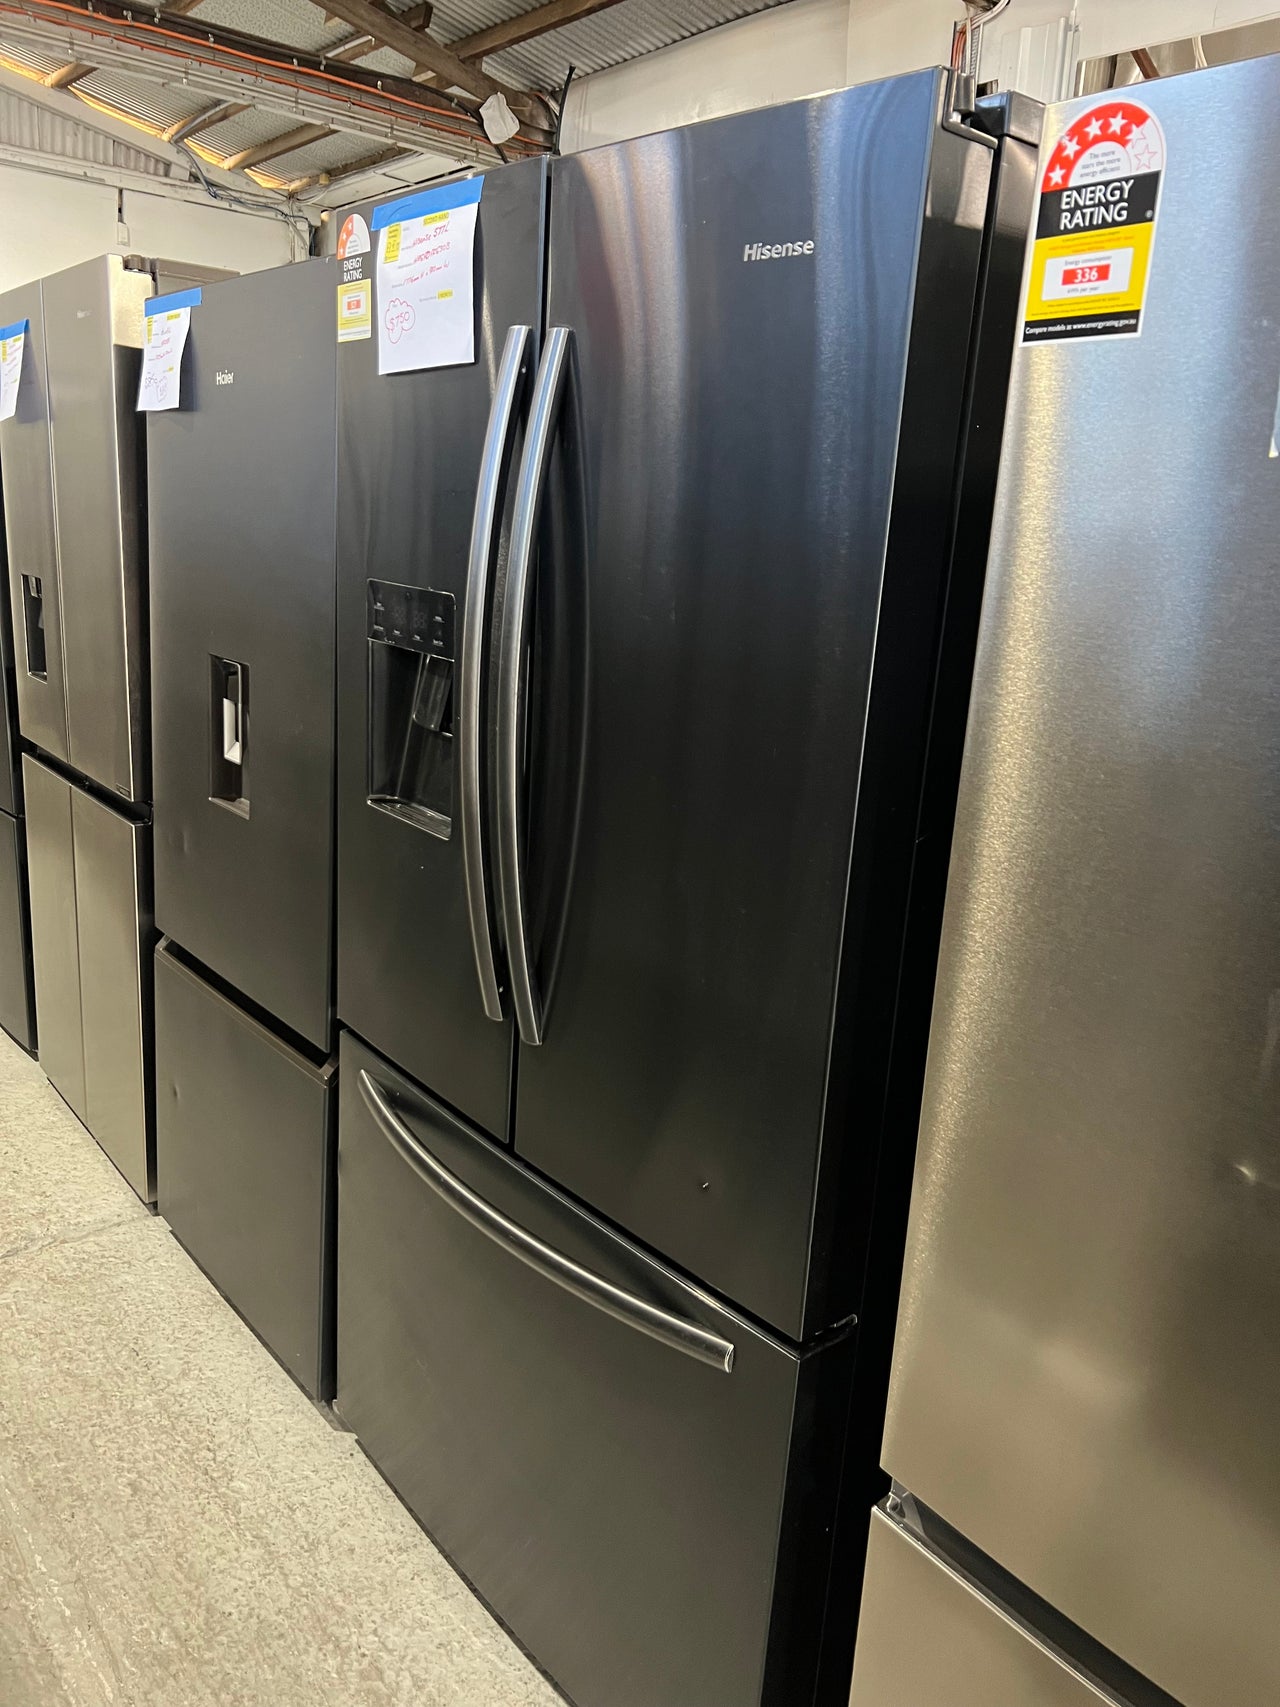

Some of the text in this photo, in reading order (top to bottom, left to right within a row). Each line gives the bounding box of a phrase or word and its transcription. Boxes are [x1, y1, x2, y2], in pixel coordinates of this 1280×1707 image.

[1061, 179, 1134, 210] ENERGY
[1060, 202, 1128, 230] RATING
[743, 240, 815, 262] Hisense
[343, 257, 363, 271] ENERGY
[343, 269, 363, 282] RATING
[1073, 267, 1098, 283] 336
[1025, 327, 1047, 335] Compare
[1048, 324, 1066, 332] models
[216, 369, 234, 386] Haier
